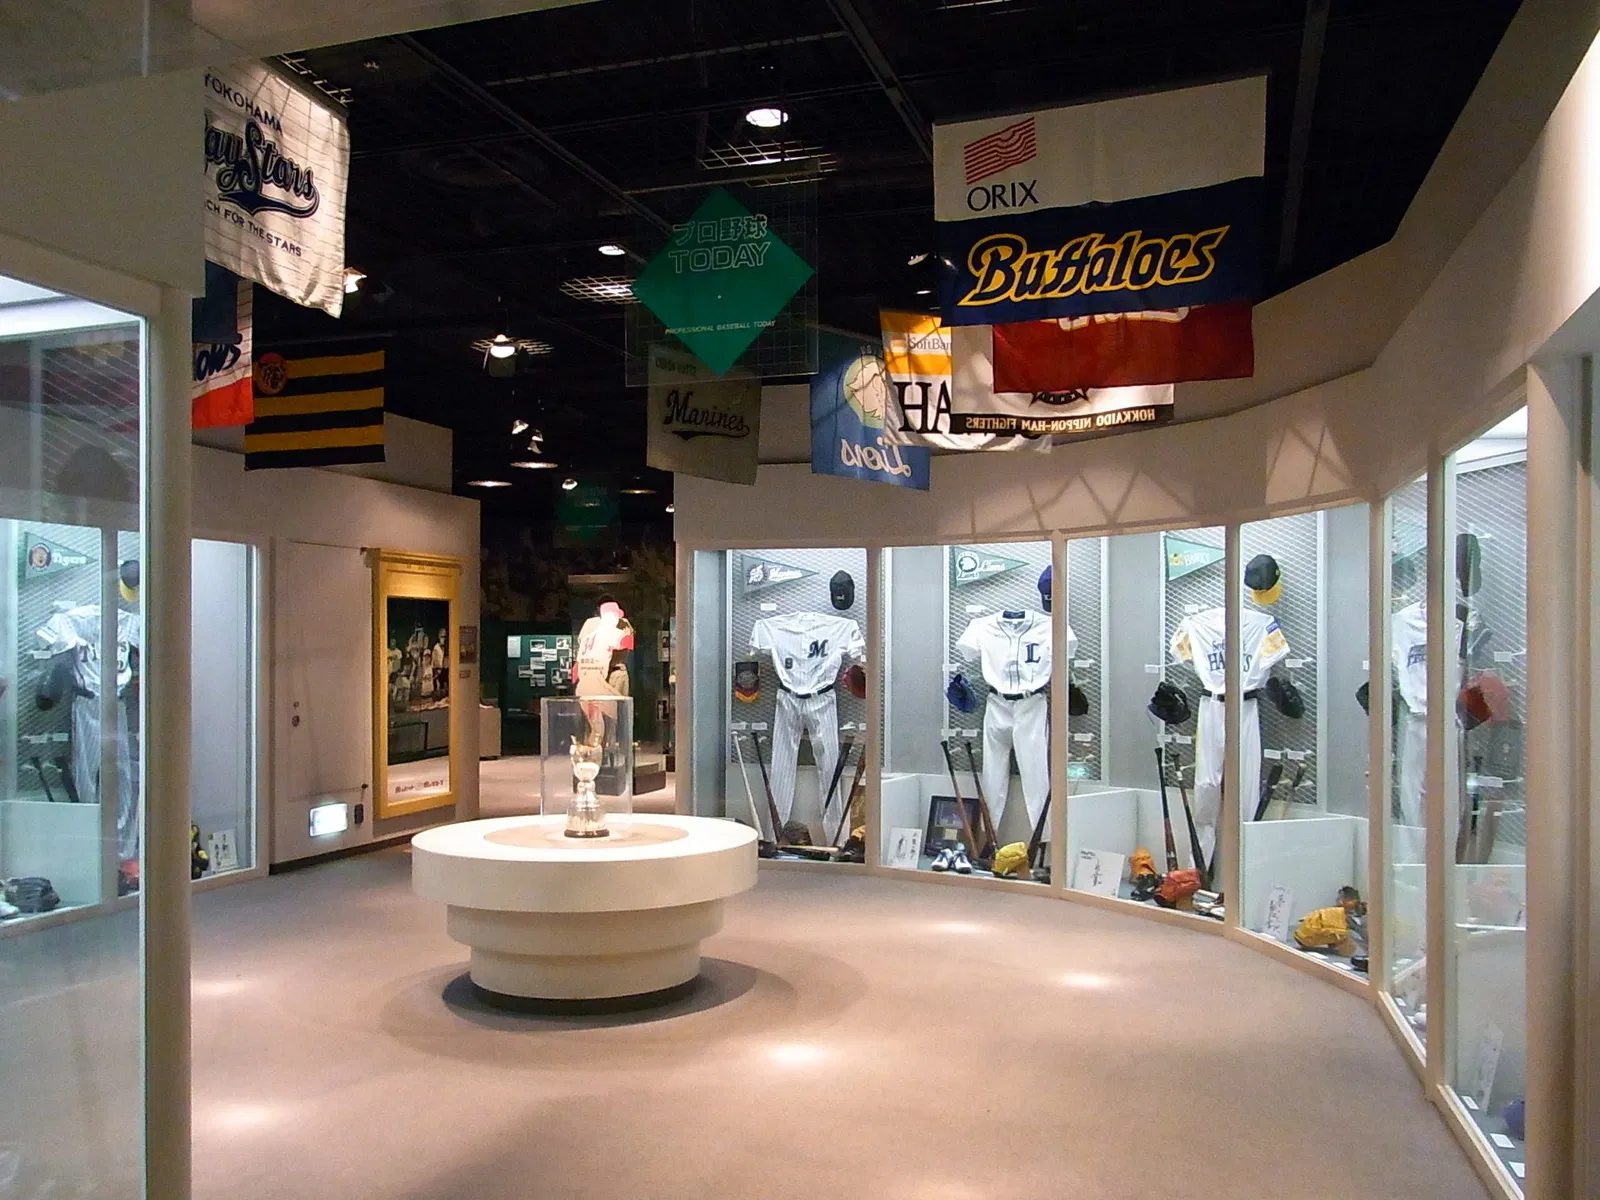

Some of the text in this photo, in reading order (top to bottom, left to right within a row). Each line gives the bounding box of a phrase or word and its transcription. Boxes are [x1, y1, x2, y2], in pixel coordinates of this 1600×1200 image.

[204, 114, 316, 201] ayStars
[967, 180, 1040, 212] ORIX
[224, 209, 246, 228] FOR
[248, 221, 266, 239] THE
[266, 233, 302, 257] STARS
[672, 213, 768, 246] プロ野球
[668, 241, 771, 274] TODAY
[957, 225, 1231, 306] Buffaloes
[664, 319, 776, 335] PROFESSIONAL BASEBALL TODAY
[663, 389, 750, 433] Marines
[807, 639, 829, 659] M
[1025, 642, 1041, 664] L
